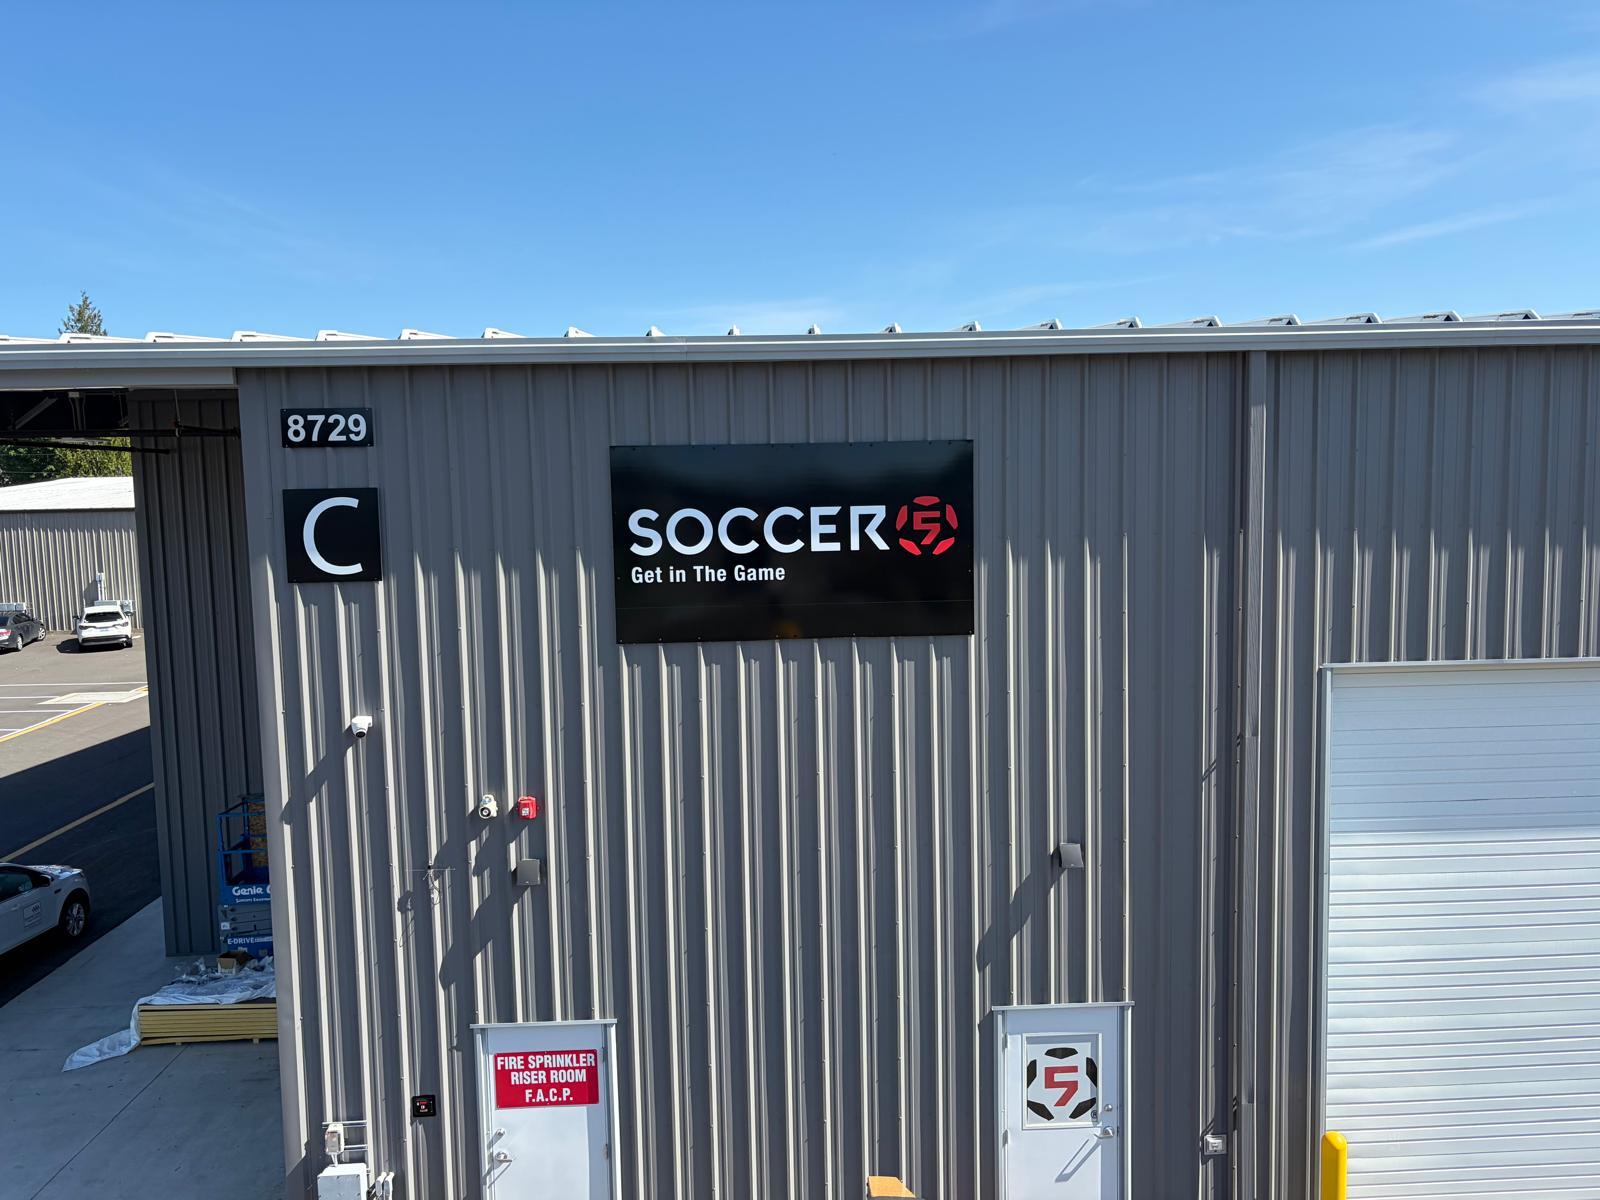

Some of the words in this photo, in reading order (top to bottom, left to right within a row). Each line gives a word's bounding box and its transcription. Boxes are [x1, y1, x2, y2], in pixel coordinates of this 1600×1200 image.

[287, 413, 367, 442] 8729
[302, 496, 363, 576] C
[628, 505, 890, 556] SOCCER
[631, 566, 663, 584] Get
[669, 566, 687, 583] in
[693, 565, 727, 583] The
[734, 564, 786, 582] Game
[231, 885, 264, 896] Genie
[496, 1056, 525, 1071] FIRE
[527, 1053, 596, 1069] SPRINKLER
[510, 1070, 547, 1085] RISER
[549, 1068, 587, 1083] ROOM
[1043, 1065, 1079, 1107] 5
[525, 1087, 574, 1103] F.A.C.P.
